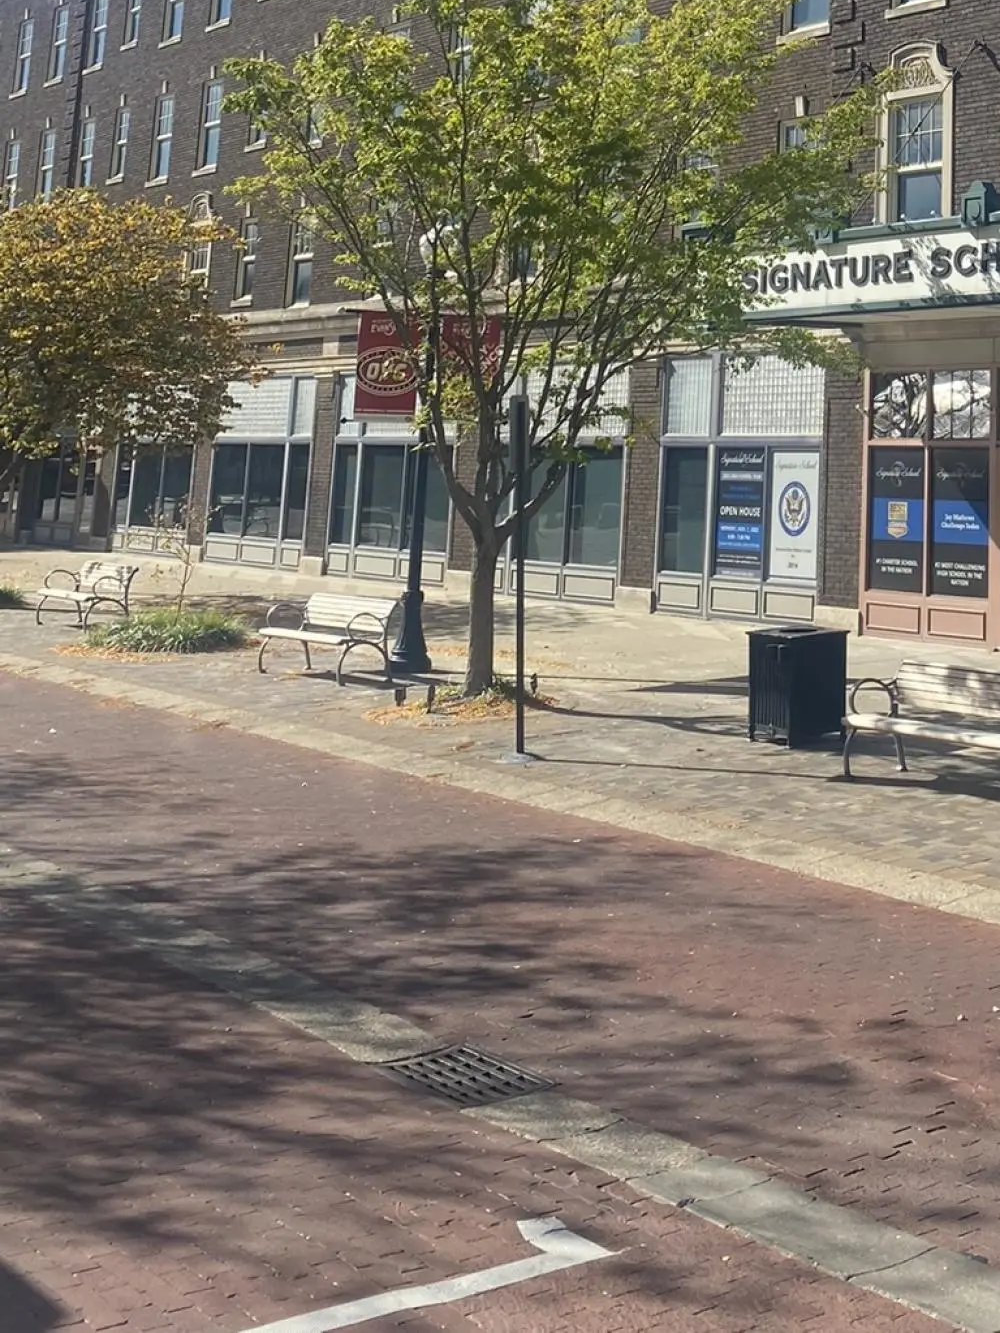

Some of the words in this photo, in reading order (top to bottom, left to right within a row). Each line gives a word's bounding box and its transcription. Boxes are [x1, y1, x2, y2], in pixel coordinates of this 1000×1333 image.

[741, 249, 914, 295] SIGNATURE
[720, 506, 738, 516] OPEN
[739, 507, 761, 518] HOUSE
